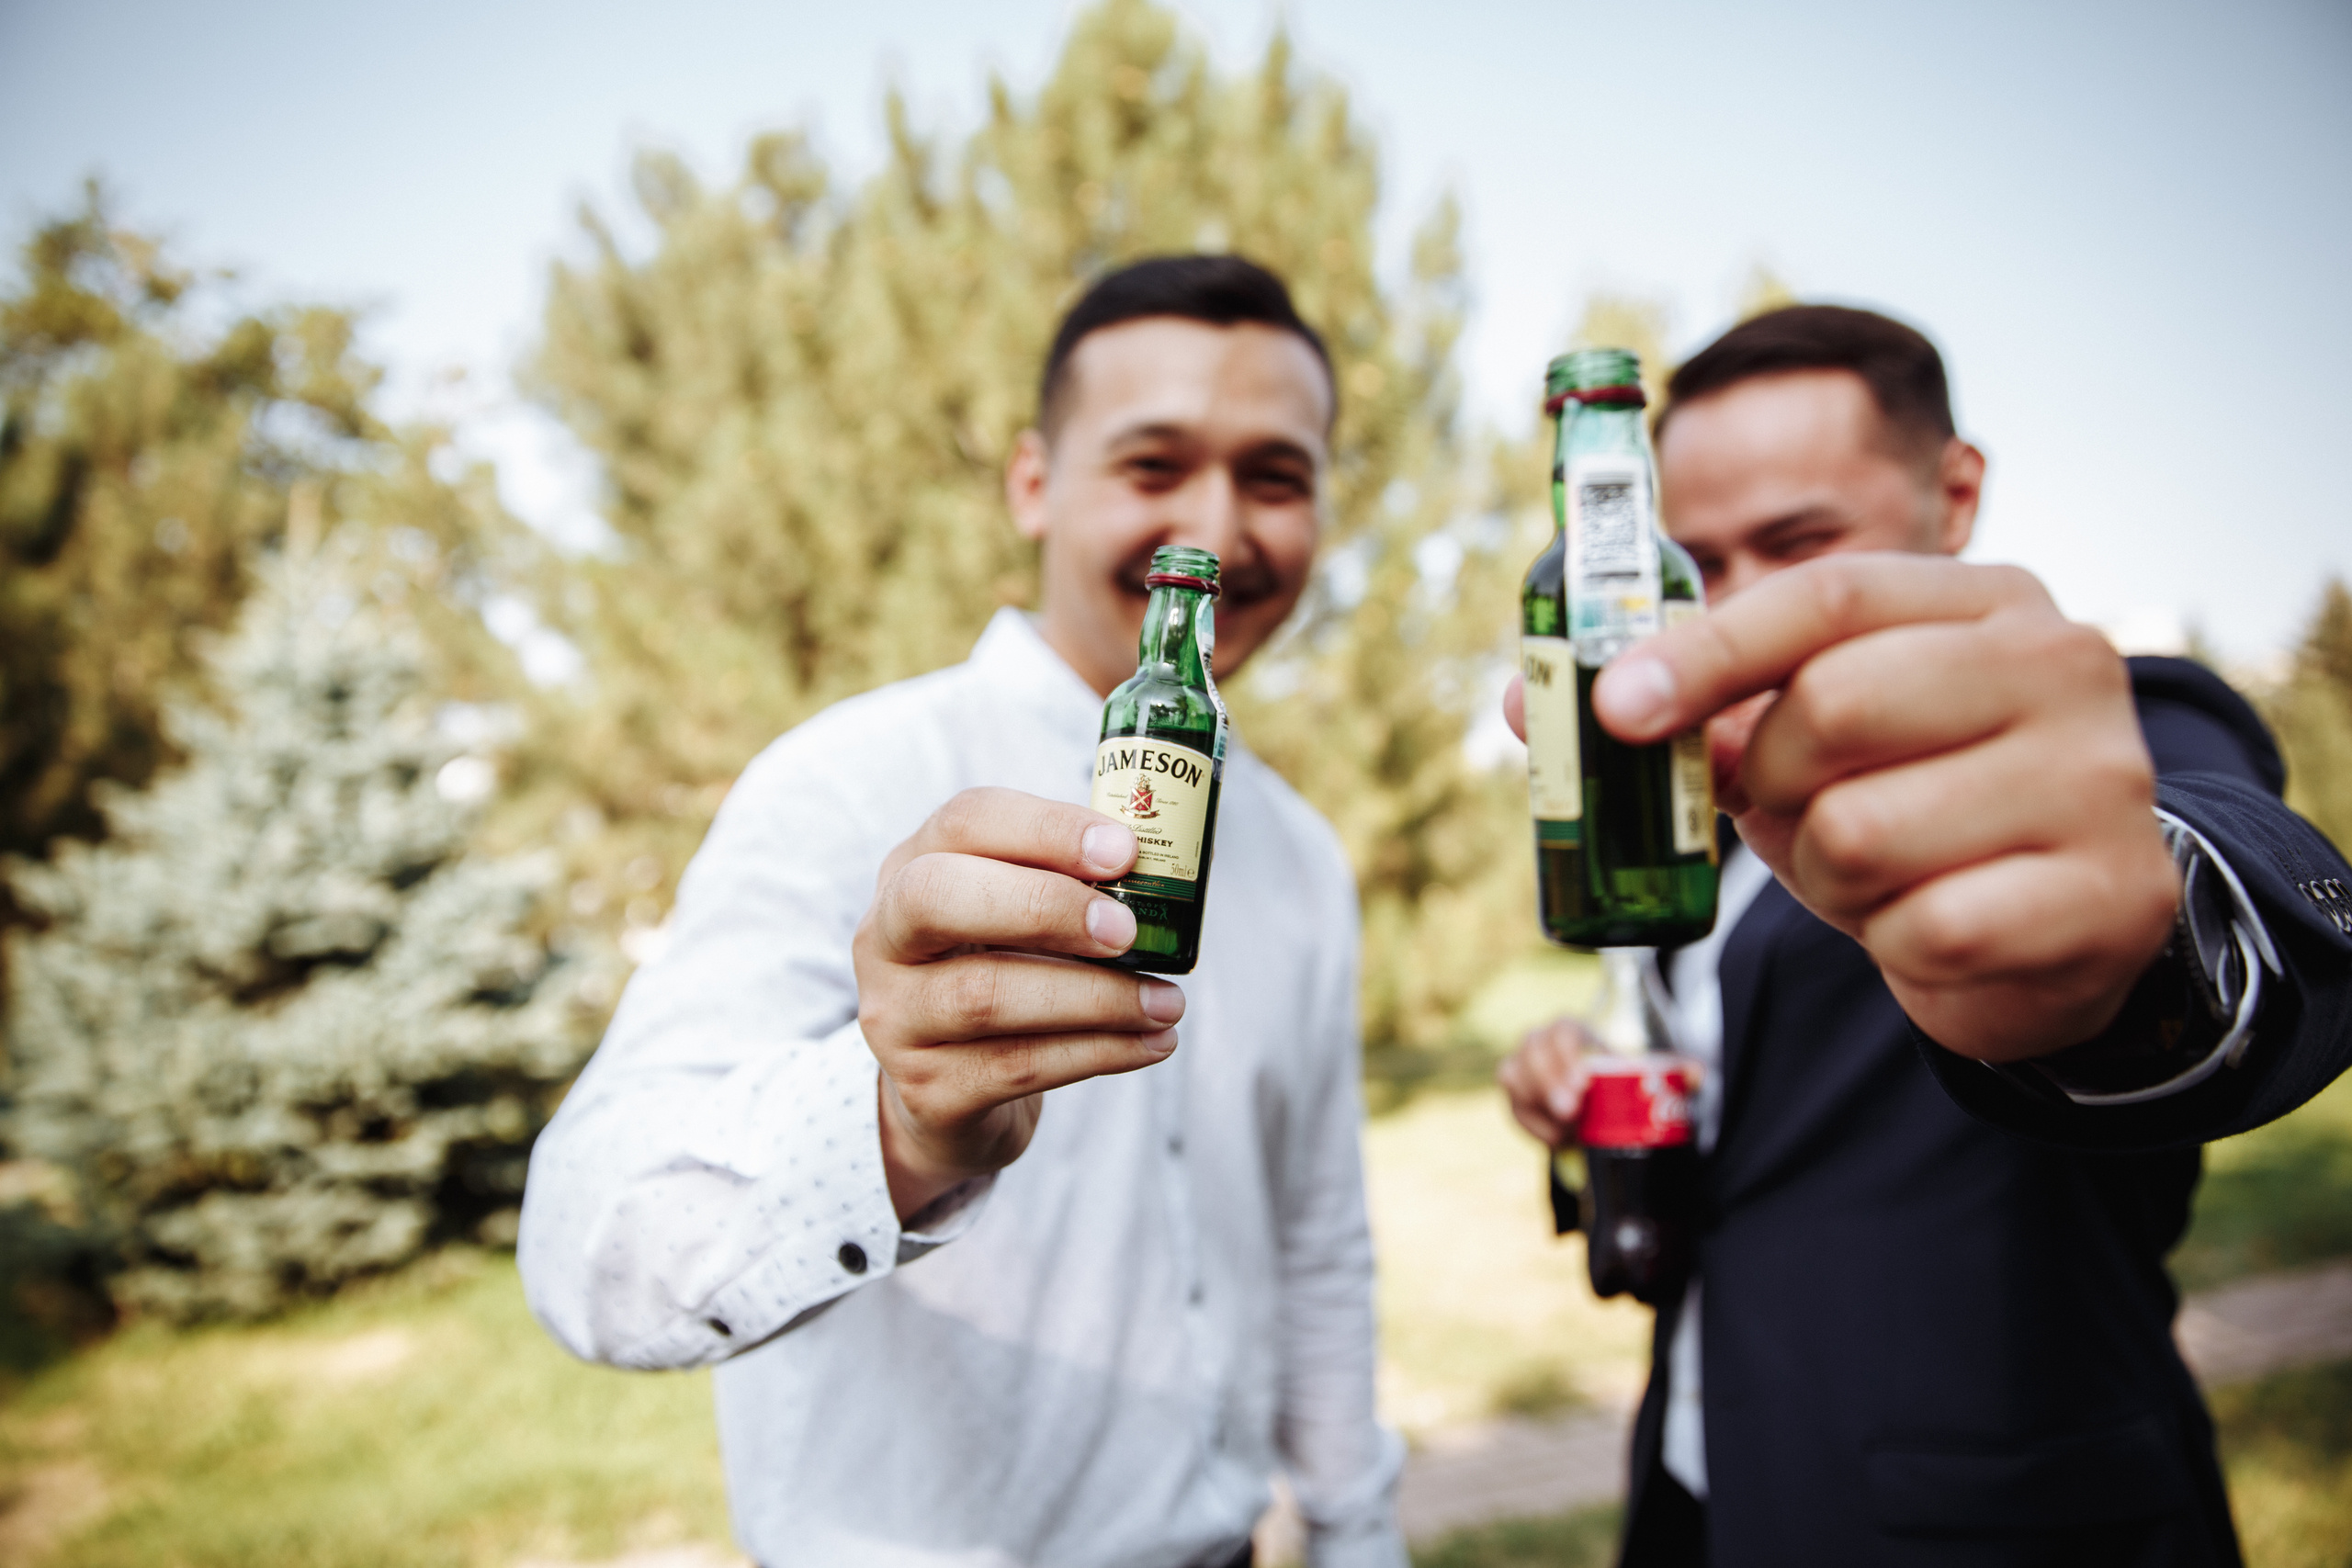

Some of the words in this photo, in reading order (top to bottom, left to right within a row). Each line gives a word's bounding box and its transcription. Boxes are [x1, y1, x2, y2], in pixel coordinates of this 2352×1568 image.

[1098, 749, 1203, 788] JAMESON
[1136, 836, 1173, 848] HISKEY
[1170, 863, 1188, 878] 50ml
